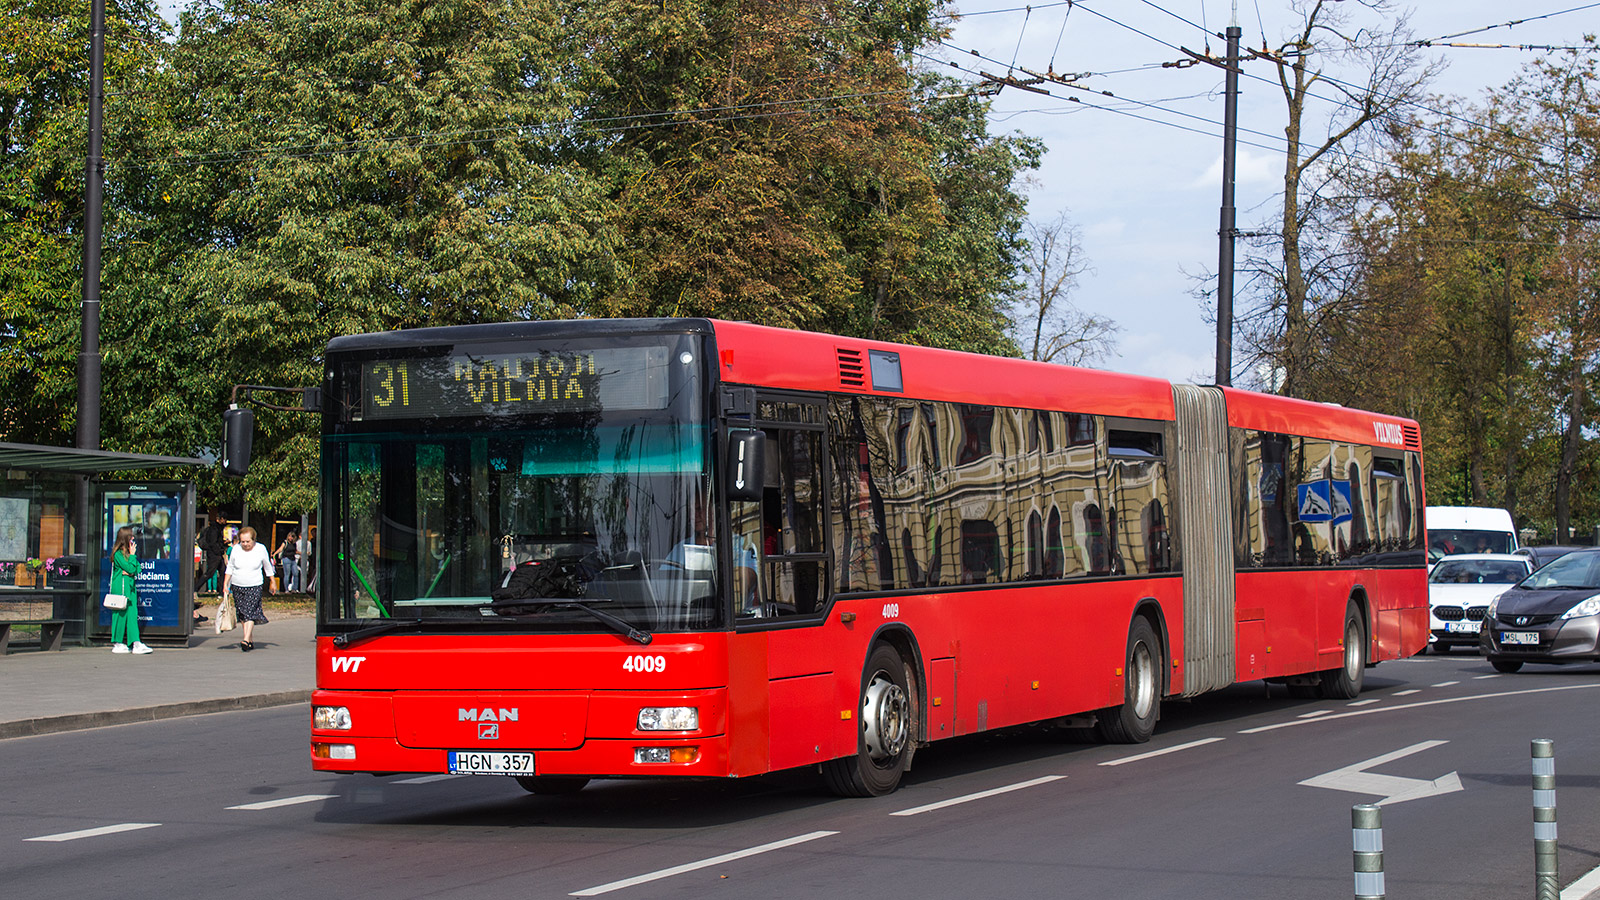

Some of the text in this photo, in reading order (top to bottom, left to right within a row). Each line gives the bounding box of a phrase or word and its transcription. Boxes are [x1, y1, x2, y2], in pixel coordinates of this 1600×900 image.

[454, 354, 595, 381] NAUJOJI
[373, 361, 409, 407] 31
[467, 378, 584, 402] VILNIA
[1372, 421, 1403, 445] VILNIUS
[140, 560, 155, 570] stui
[882, 603, 899, 618] 4009
[1471, 623, 1480, 631] 15
[1504, 634, 1538, 642] MSL 175
[622, 655, 666, 672] 4009
[458, 708, 519, 721] MAN
[458, 754, 492, 770] HGN
[502, 755, 531, 770] 357
